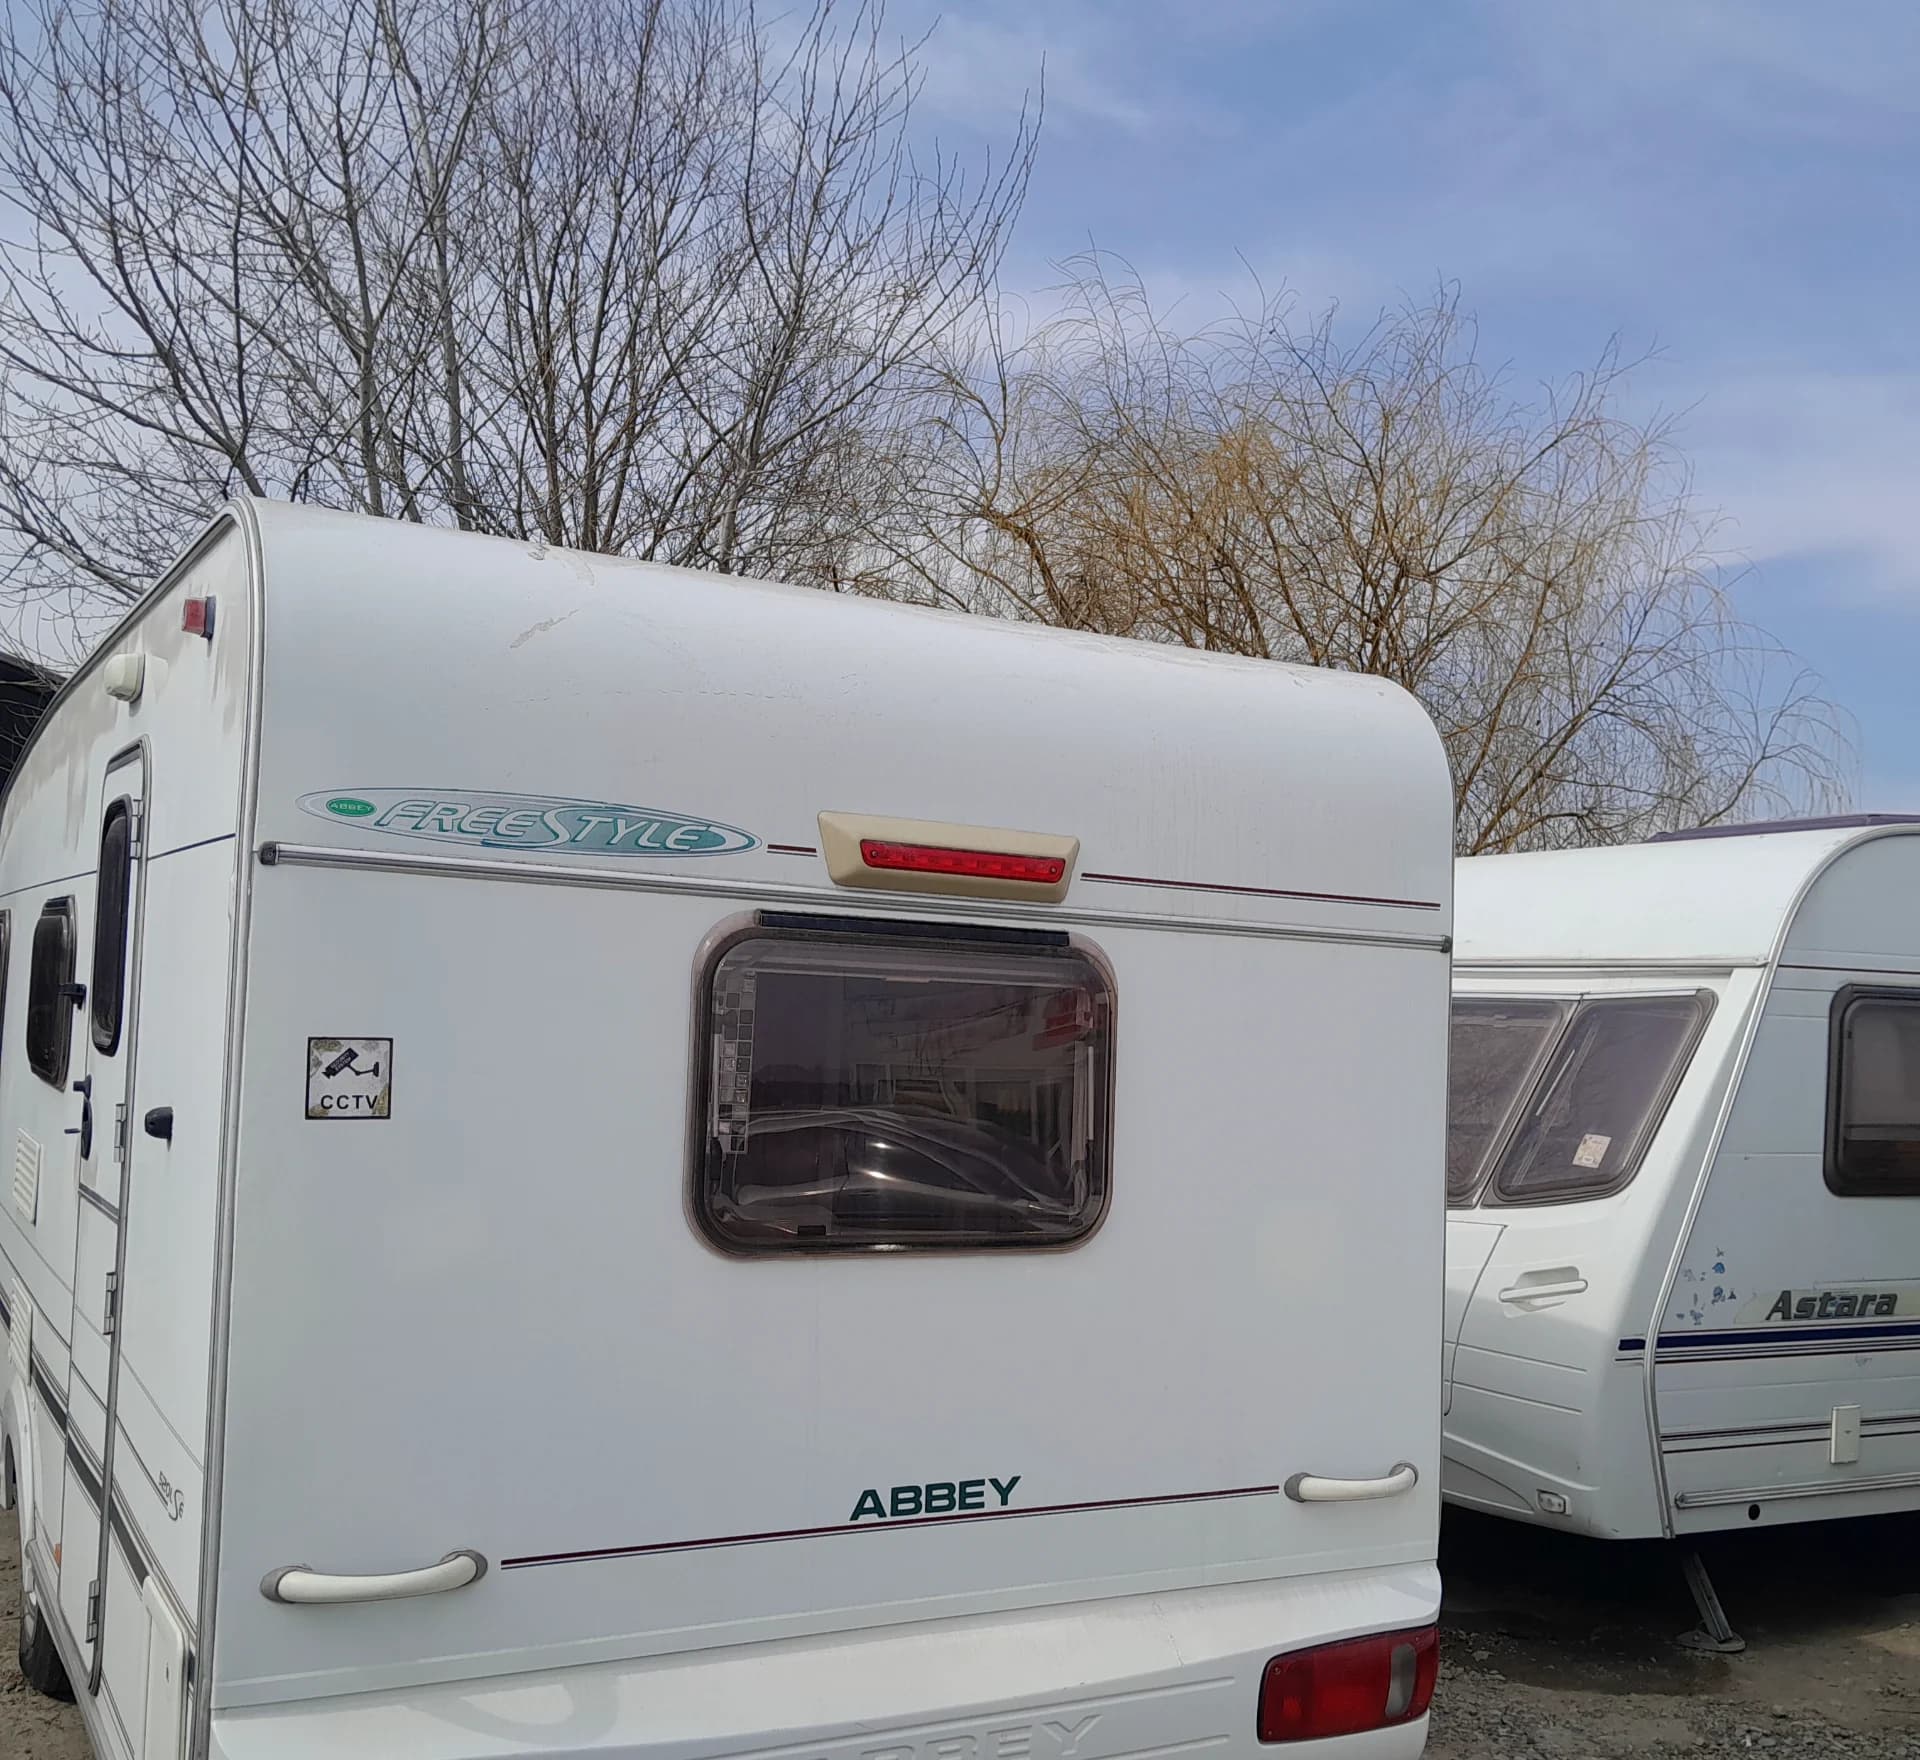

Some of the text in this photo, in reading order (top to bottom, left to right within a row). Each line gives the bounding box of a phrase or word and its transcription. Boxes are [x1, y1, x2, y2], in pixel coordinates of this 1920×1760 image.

[330, 803, 372, 812] ABBEY
[320, 1094, 378, 1110] CCTV
[1765, 1290, 1898, 1321] Astara
[849, 1475, 1022, 1521] ABBEY
